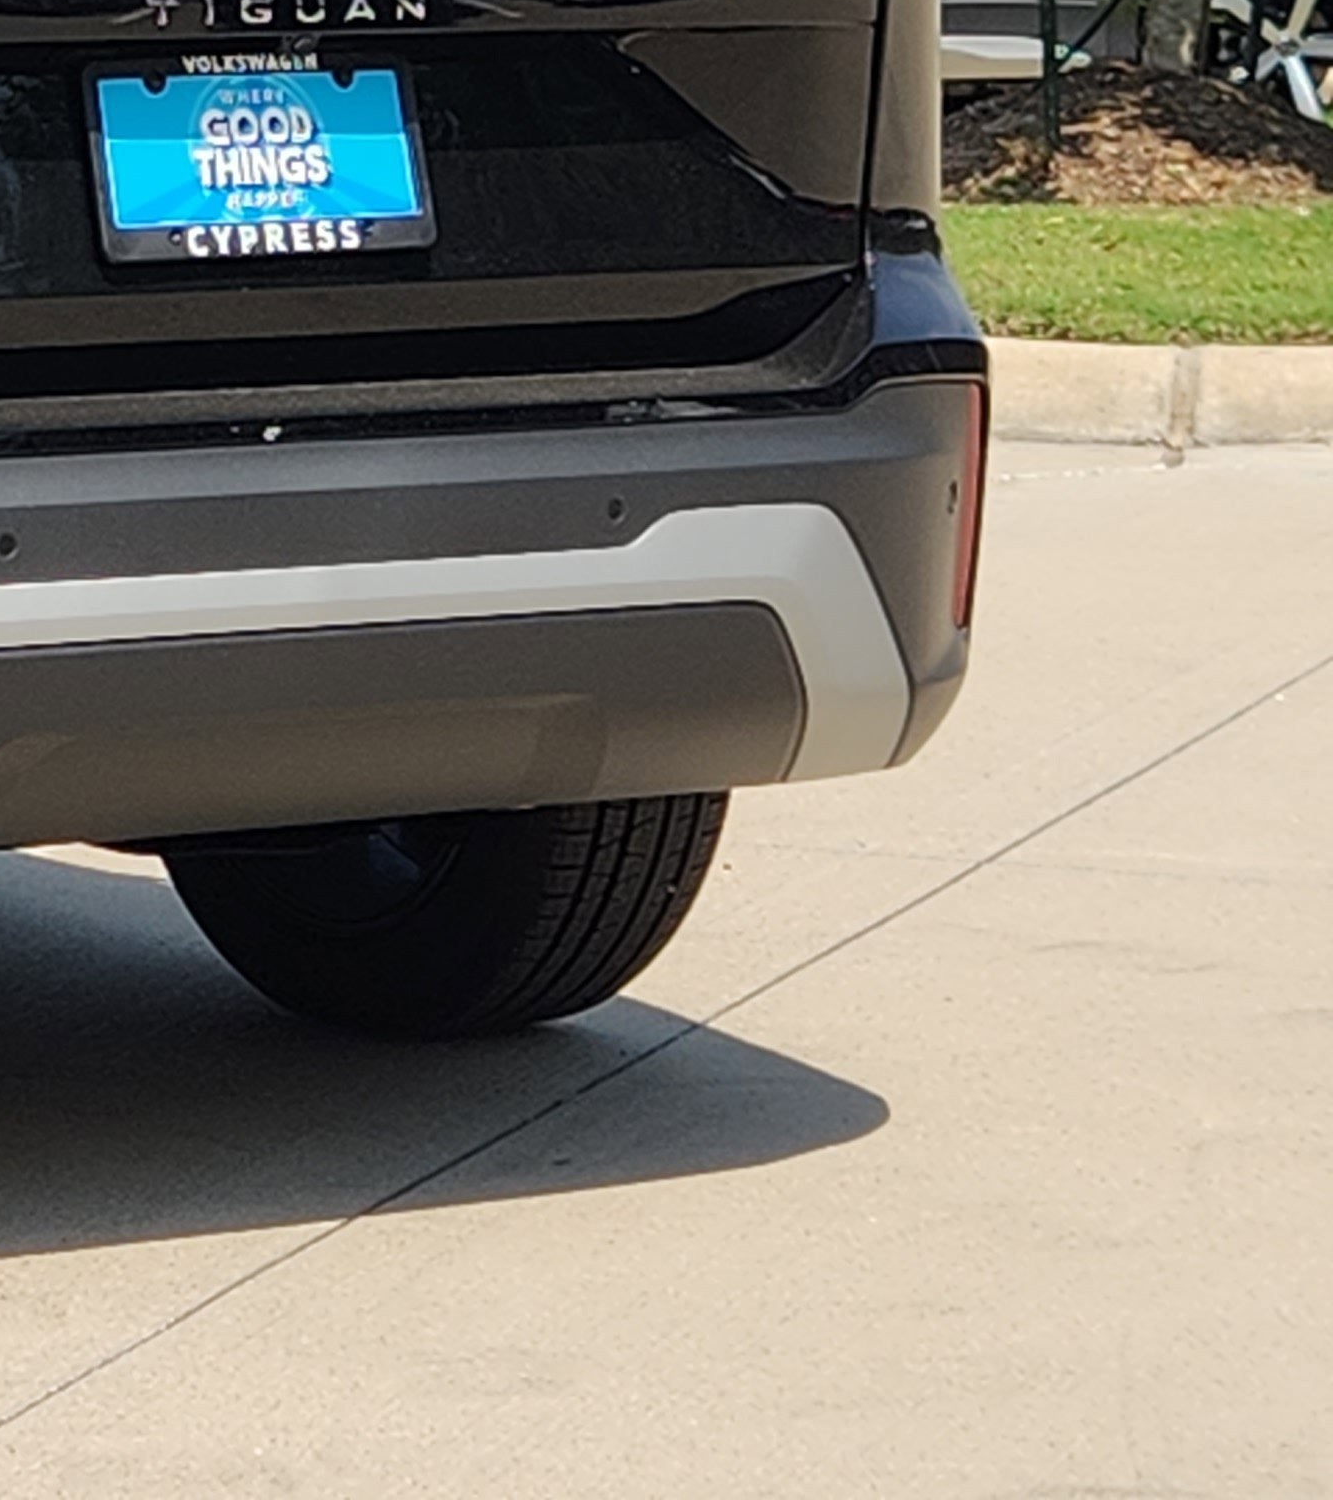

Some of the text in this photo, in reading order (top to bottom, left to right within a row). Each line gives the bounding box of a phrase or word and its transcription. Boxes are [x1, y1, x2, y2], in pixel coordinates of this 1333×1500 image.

[182, 53, 319, 74] VOLKSWAGEN
[199, 106, 313, 147] GOOD
[193, 144, 329, 188] THINGS
[187, 219, 361, 257] CYPRESS
